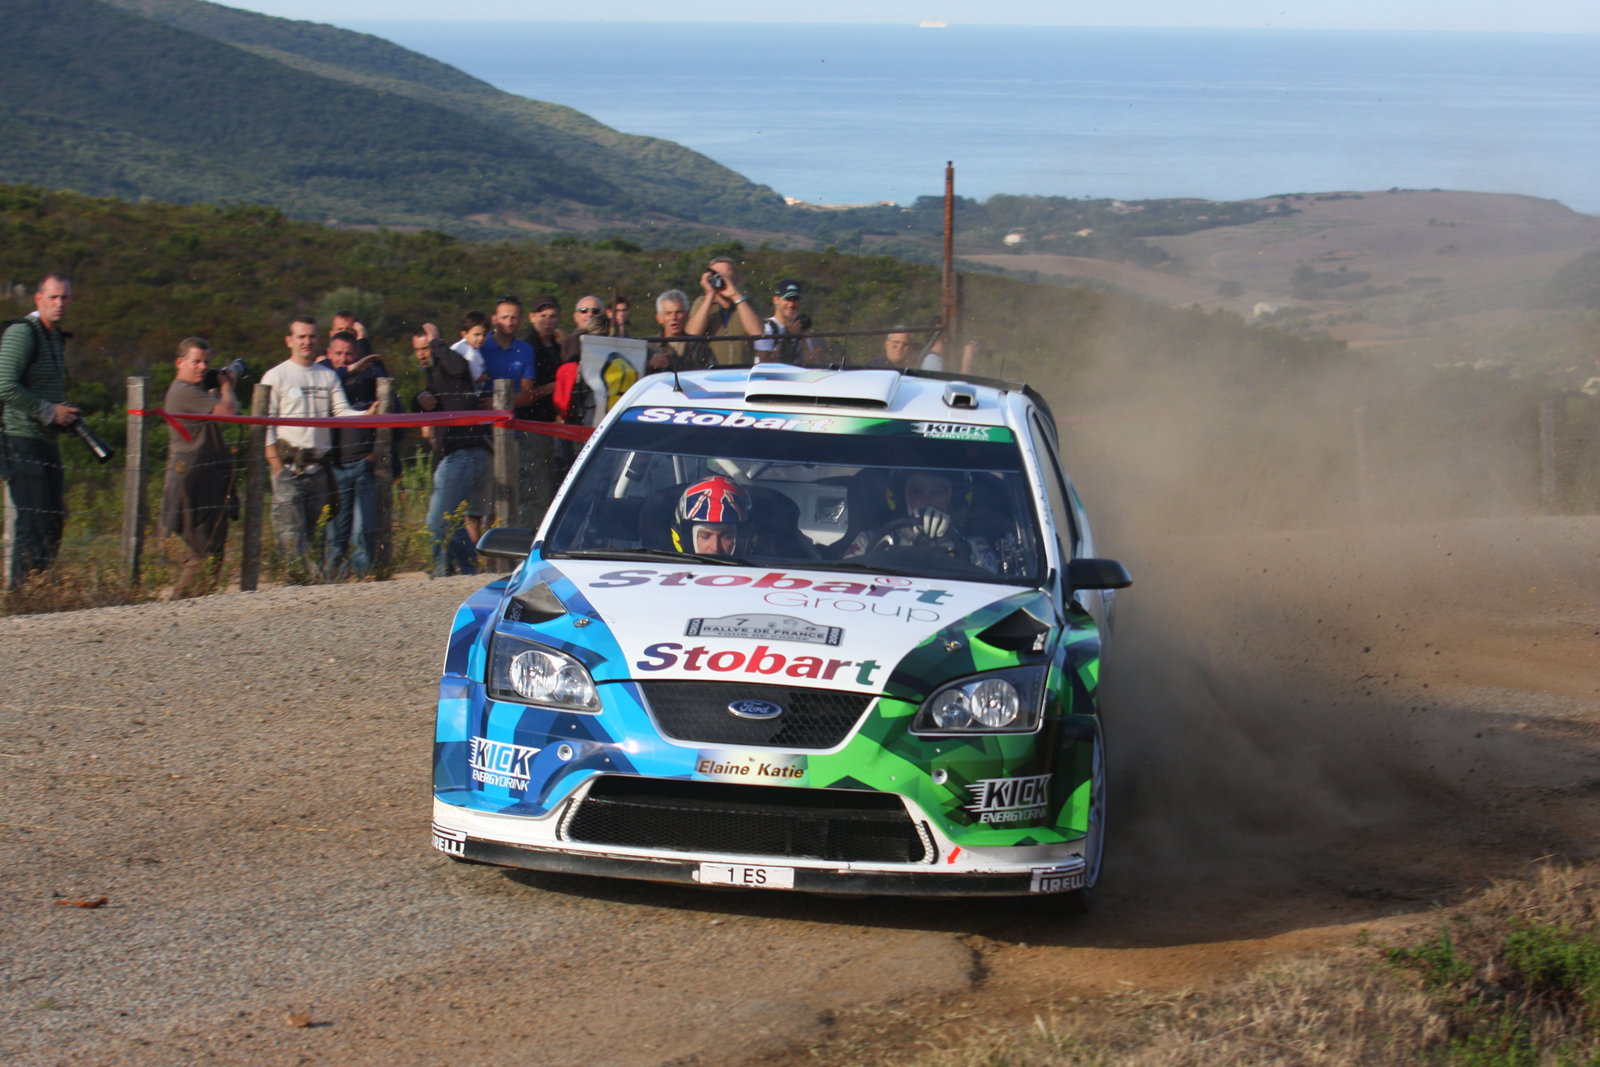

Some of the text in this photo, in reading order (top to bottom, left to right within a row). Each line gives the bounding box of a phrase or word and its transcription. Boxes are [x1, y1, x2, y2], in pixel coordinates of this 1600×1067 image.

[637, 407, 834, 432] Stobart
[588, 569, 954, 606] Stobart
[763, 591, 941, 622] Group
[702, 625, 749, 633] RALLYE
[774, 629, 825, 639] FRANCE
[735, 617, 749, 626] 7
[636, 642, 882, 686] Stobart
[739, 701, 771, 714] Ford
[470, 736, 541, 780] KICK
[697, 760, 804, 779] Elaine Katie
[472, 769, 530, 792] ENERGYDRINK
[970, 773, 1053, 811] KICK
[727, 867, 768, 885] 1 ES
